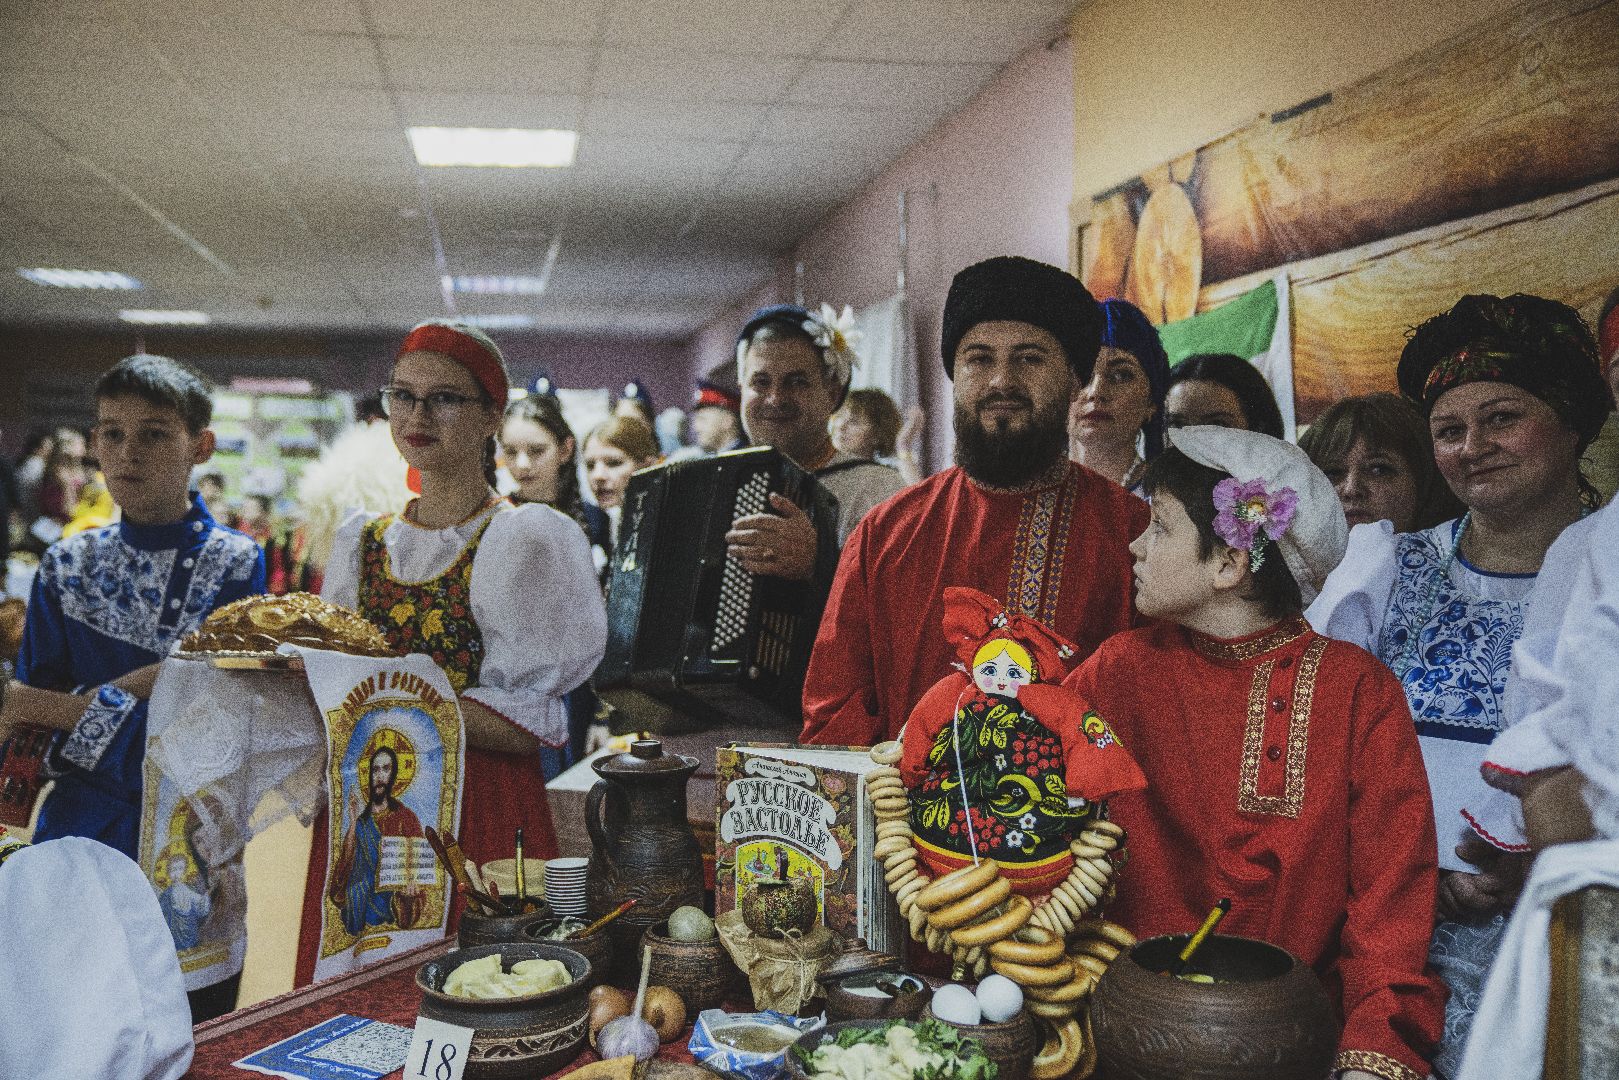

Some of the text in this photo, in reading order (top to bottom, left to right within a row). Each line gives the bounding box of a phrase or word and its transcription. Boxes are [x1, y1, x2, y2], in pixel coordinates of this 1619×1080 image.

[735, 780, 824, 824] РУССКОЕ
[730, 806, 831, 857] ЗАСТОЛЬЕ
[416, 1038, 457, 1080] 18
